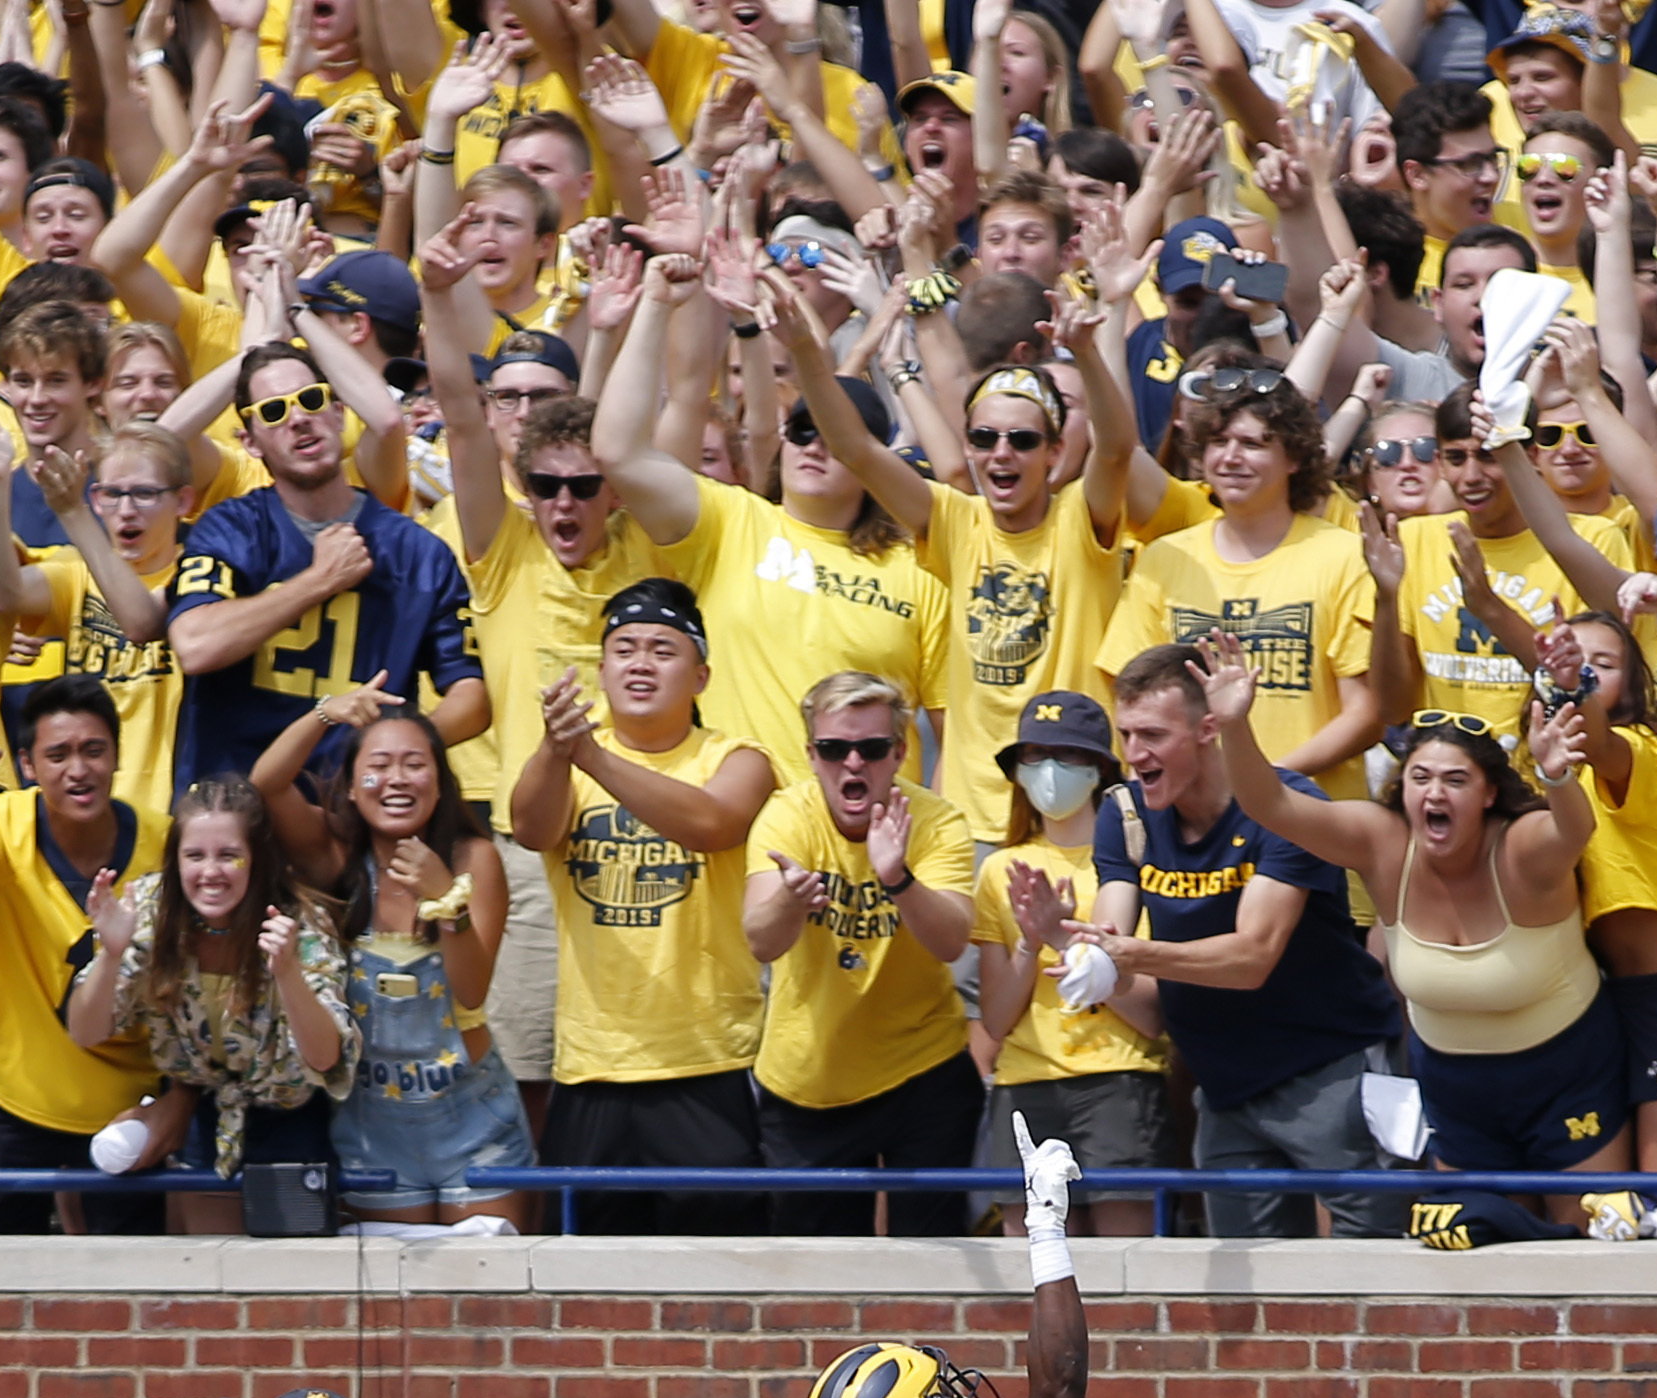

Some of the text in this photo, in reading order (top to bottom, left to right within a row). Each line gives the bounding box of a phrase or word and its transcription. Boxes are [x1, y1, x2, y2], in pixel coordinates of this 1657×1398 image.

[176, 555, 236, 600] 21
[1230, 600, 1253, 617] M
[1421, 570, 1557, 626] MIIGAN
[251, 582, 364, 699] 21
[1259, 638, 1308, 651] THE
[974, 665, 1019, 683] 2019
[1250, 650, 1307, 684] USE
[1034, 704, 1063, 722] M
[600, 907, 652, 926] 2019
[396, 1061, 465, 1092] blue
[1564, 1111, 1602, 1141] M
